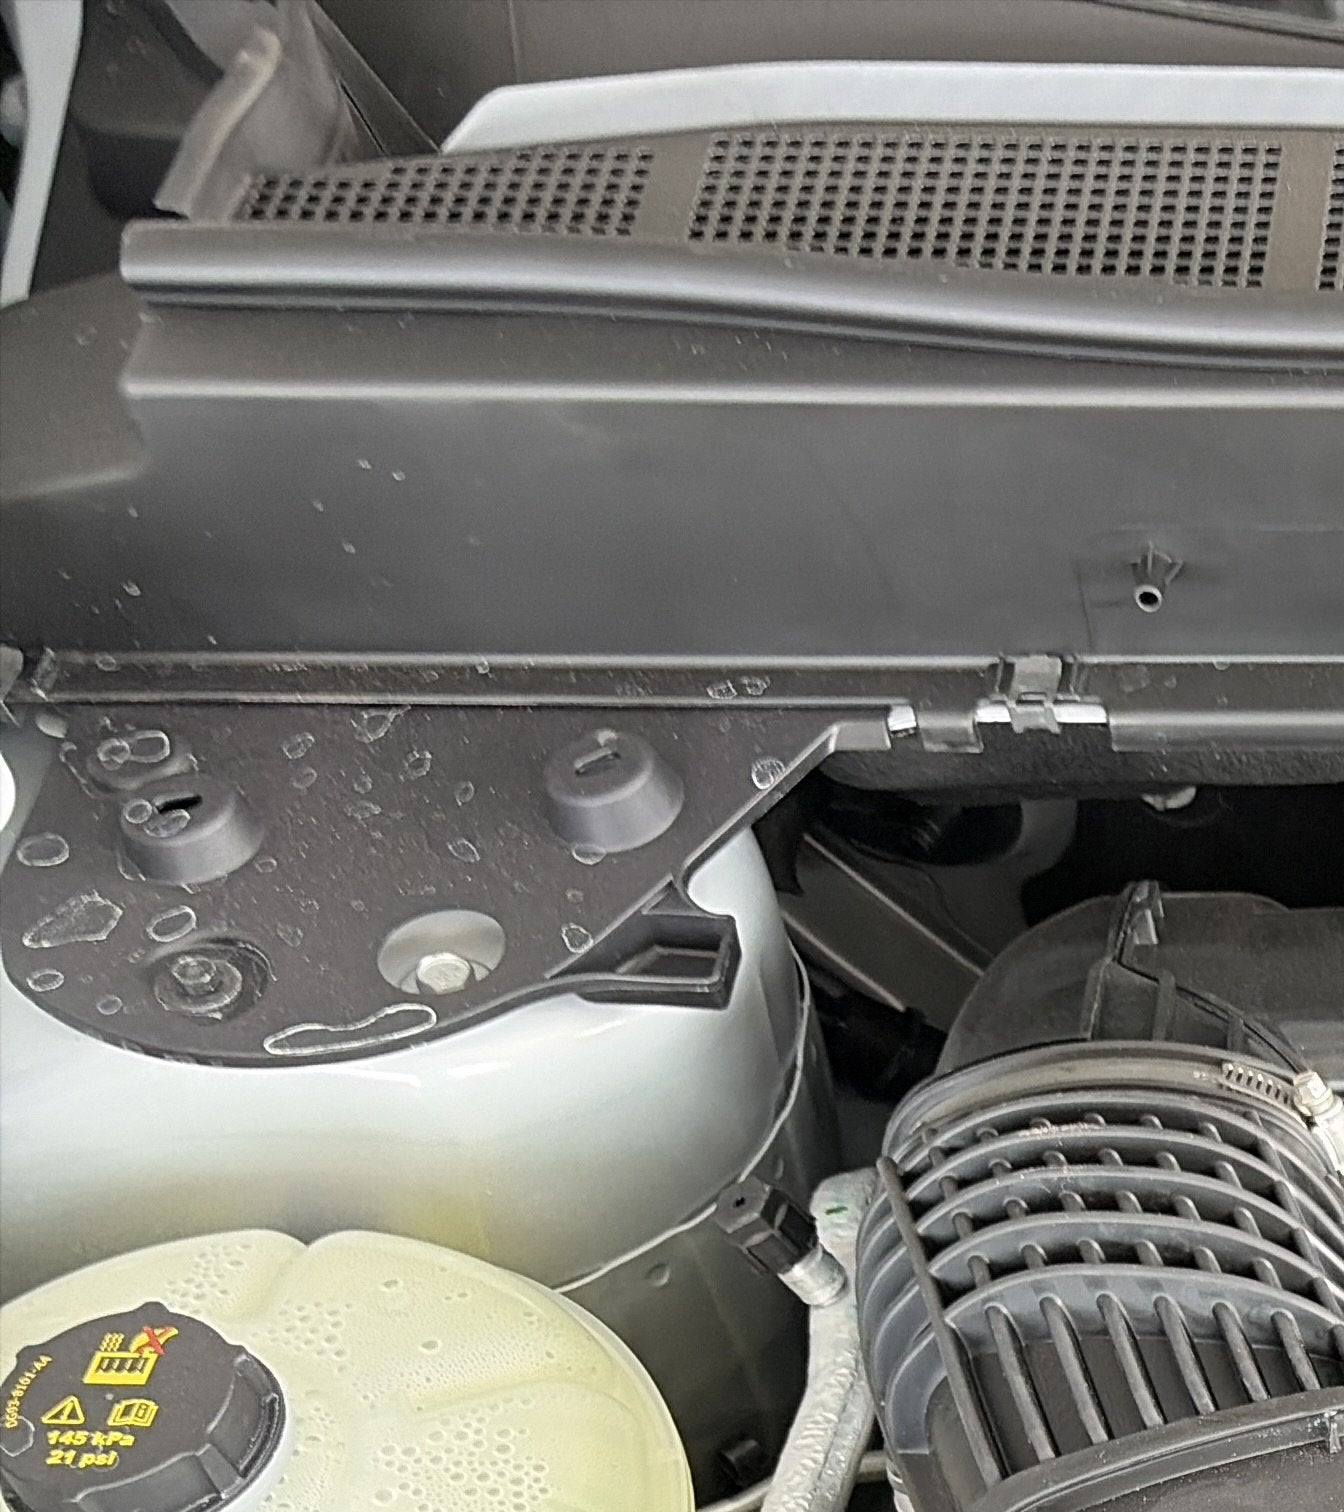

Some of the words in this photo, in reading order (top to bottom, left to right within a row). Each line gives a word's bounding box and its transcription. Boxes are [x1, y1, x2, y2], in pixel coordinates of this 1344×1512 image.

[47, 1431, 90, 1446] 145
[91, 1430, 136, 1446] kPa
[46, 1450, 76, 1465] 21
[79, 1450, 119, 1468] psi
